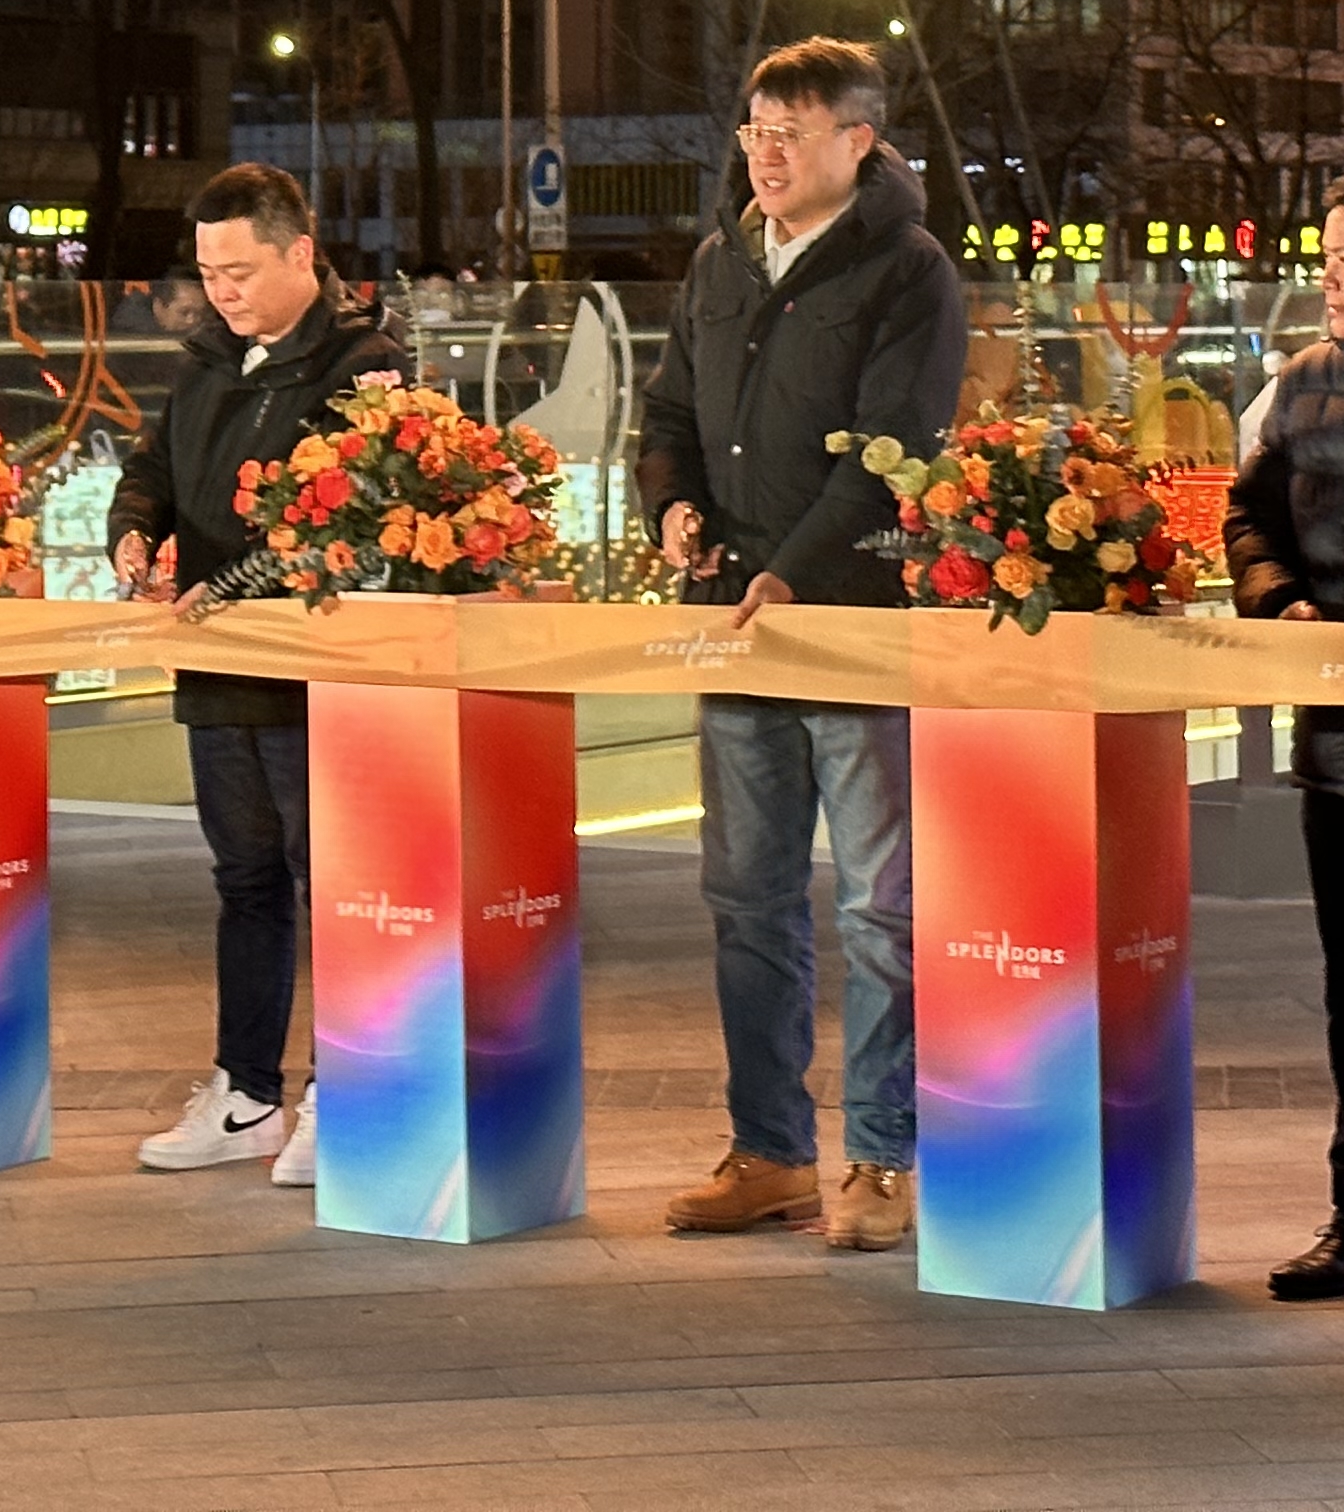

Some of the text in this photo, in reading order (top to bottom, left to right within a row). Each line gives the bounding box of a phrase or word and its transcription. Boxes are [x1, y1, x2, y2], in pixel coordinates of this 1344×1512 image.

[642, 629, 754, 669] SPLENDORS
[335, 890, 435, 935] SPLENDORS
[482, 884, 561, 929] SPLENDORS
[946, 929, 1066, 977] SPLENDORS
